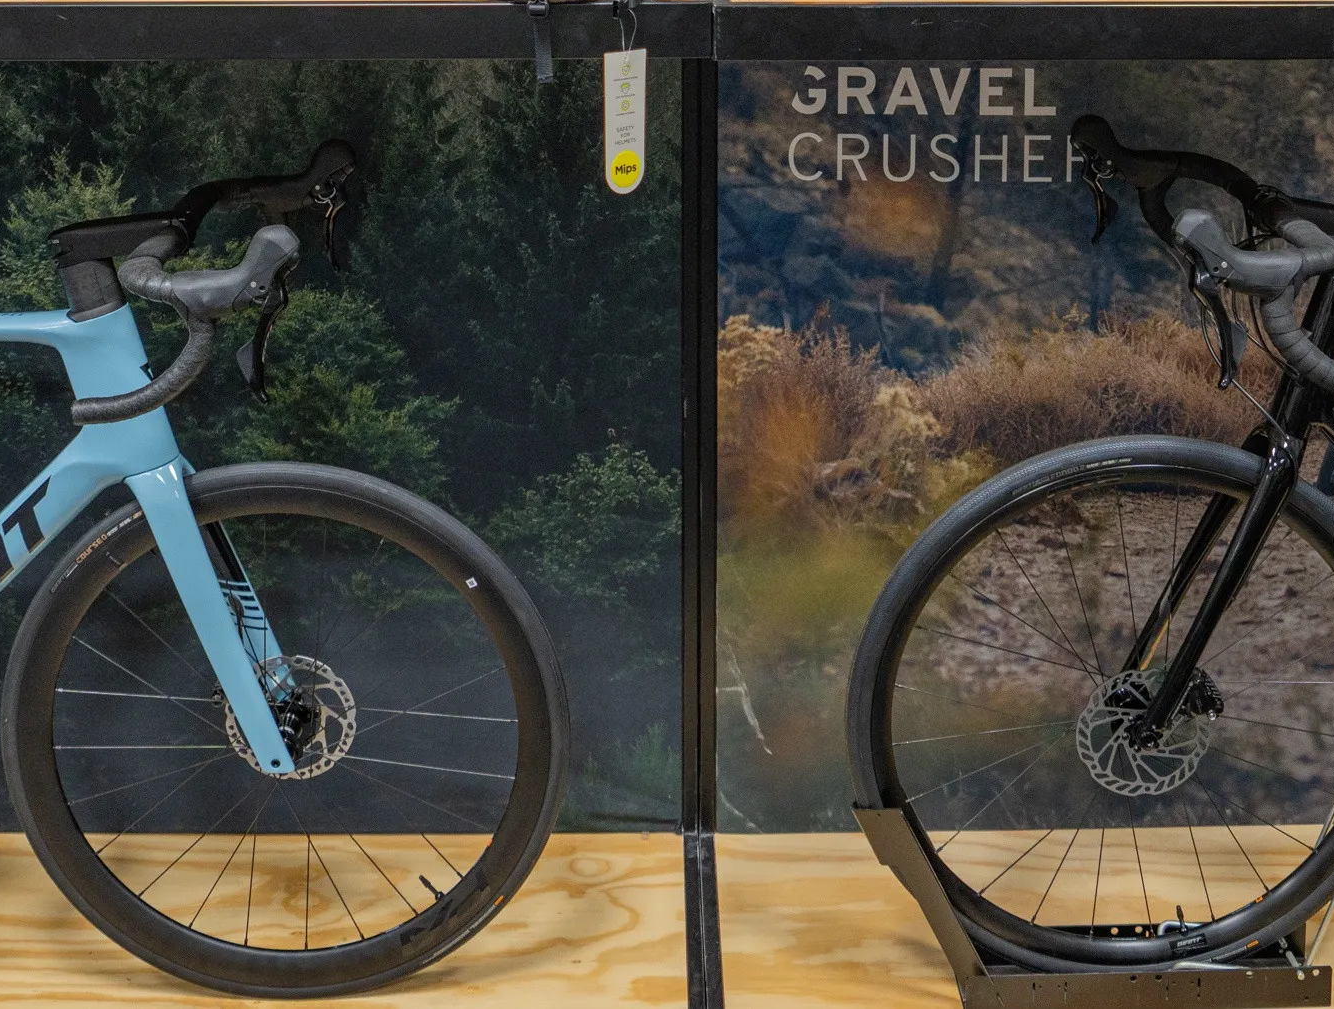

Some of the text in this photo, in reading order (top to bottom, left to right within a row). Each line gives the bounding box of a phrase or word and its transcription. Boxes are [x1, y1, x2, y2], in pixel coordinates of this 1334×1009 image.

[791, 65, 1057, 116] GRAVEL
[616, 125, 635, 133] SAFETY
[614, 138, 637, 146] HELMETS
[615, 163, 637, 176] Mips
